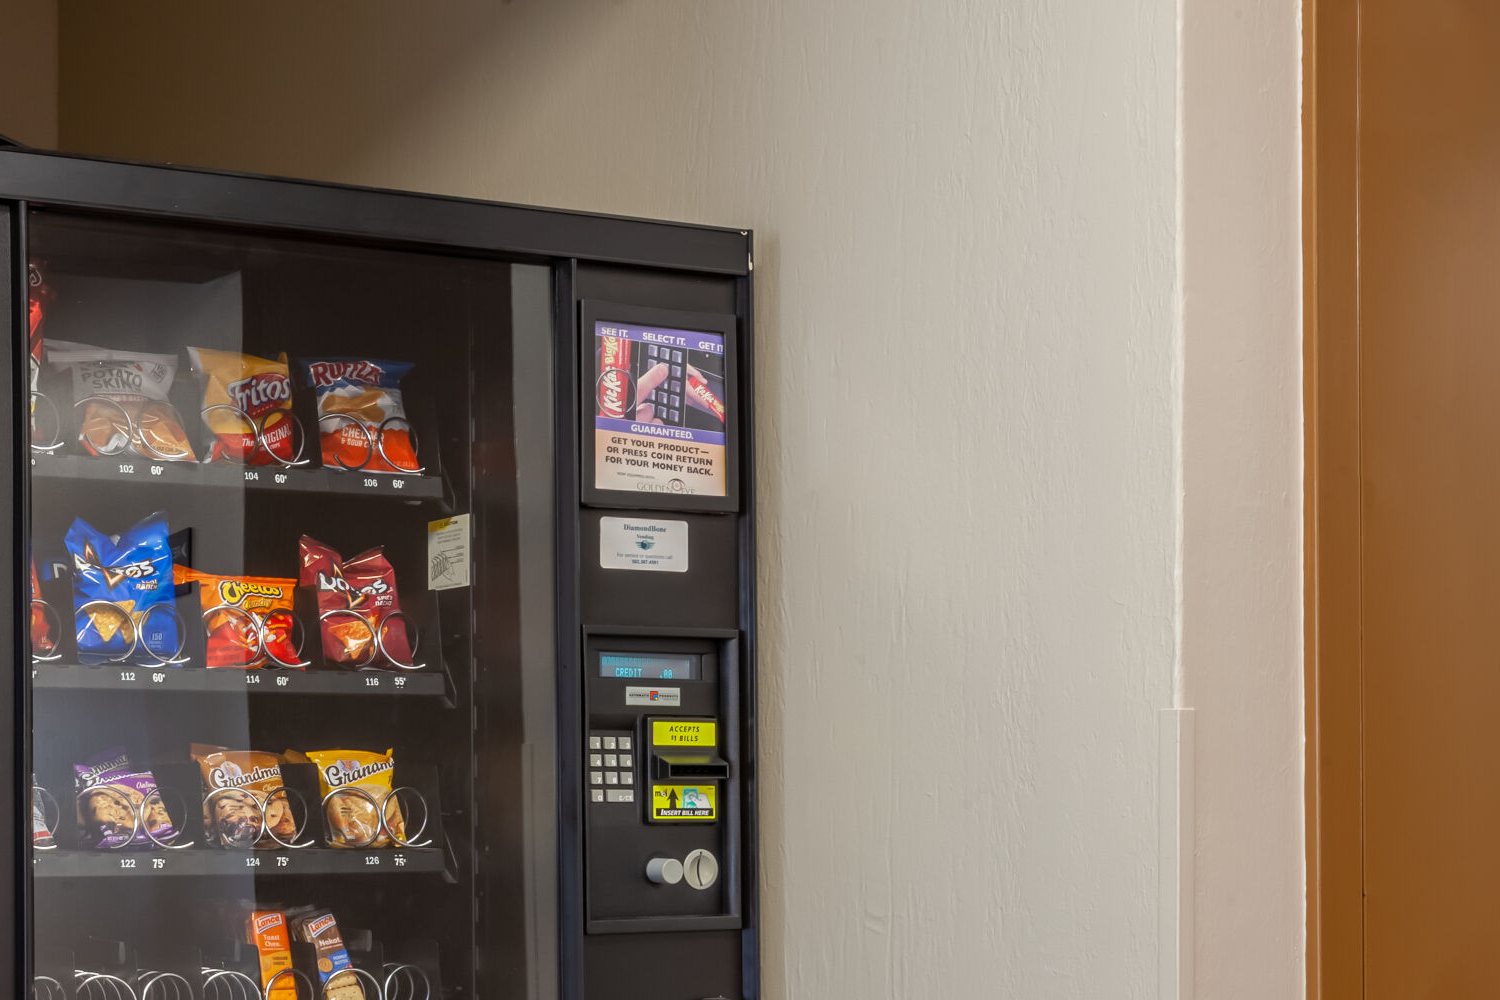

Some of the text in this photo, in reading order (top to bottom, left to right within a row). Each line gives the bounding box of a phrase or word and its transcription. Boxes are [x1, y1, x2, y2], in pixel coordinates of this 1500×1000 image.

[601, 327, 628, 338] SEE IT.
[642, 332, 686, 346] SELECT IT.
[698, 341, 716, 350] GET
[92, 378, 137, 390] SKIN
[227, 376, 290, 413] Fritos
[630, 424, 694, 440] GUARANTEED.
[612, 436, 628, 445] GET
[631, 439, 654, 448] YOUR
[622, 448, 648, 458] PRESS
[651, 452, 672, 461] COIN
[676, 455, 712, 466] RETURN
[119, 464, 134, 474] 102
[606, 456, 714, 476] FOR YOUR MONEY BACK.
[244, 472, 258, 480] 104
[364, 478, 378, 487] 106
[121, 672, 136, 681] 112
[615, 668, 642, 678] CREDIT
[246, 676, 260, 684] 114
[366, 678, 379, 686] 116
[120, 859, 136, 868] 122
[246, 858, 260, 866] 124
[365, 856, 380, 864] 126
[256, 916, 280, 929] Lance
[310, 916, 334, 932] Lance
